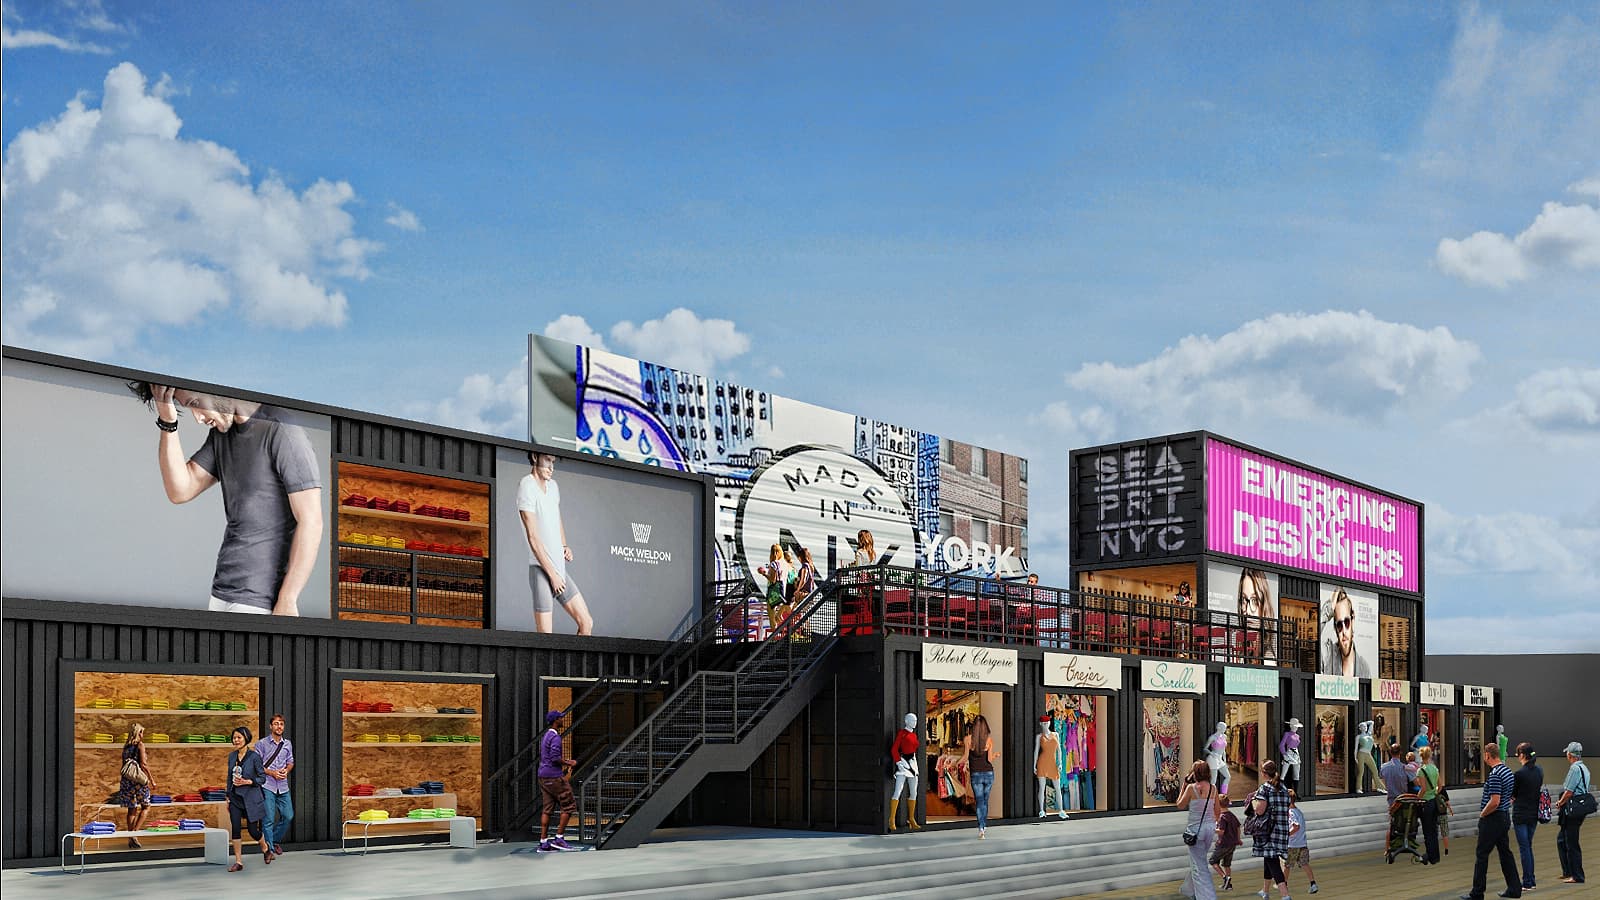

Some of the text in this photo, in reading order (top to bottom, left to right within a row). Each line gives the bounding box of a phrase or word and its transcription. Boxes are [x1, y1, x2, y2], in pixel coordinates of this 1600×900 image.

[1094, 446, 1184, 483] SEA
[782, 464, 884, 505] MADE
[1241, 457, 1396, 534] EMERGING
[820, 499, 850, 522] IN
[610, 545, 671, 561] MACK WELDON
[919, 531, 1015, 577] YORK
[1101, 525, 1185, 556] NYC
[1233, 509, 1404, 580] DESIGNERS
[925, 644, 966, 664] Robert
[961, 671, 980, 679] PARIS
